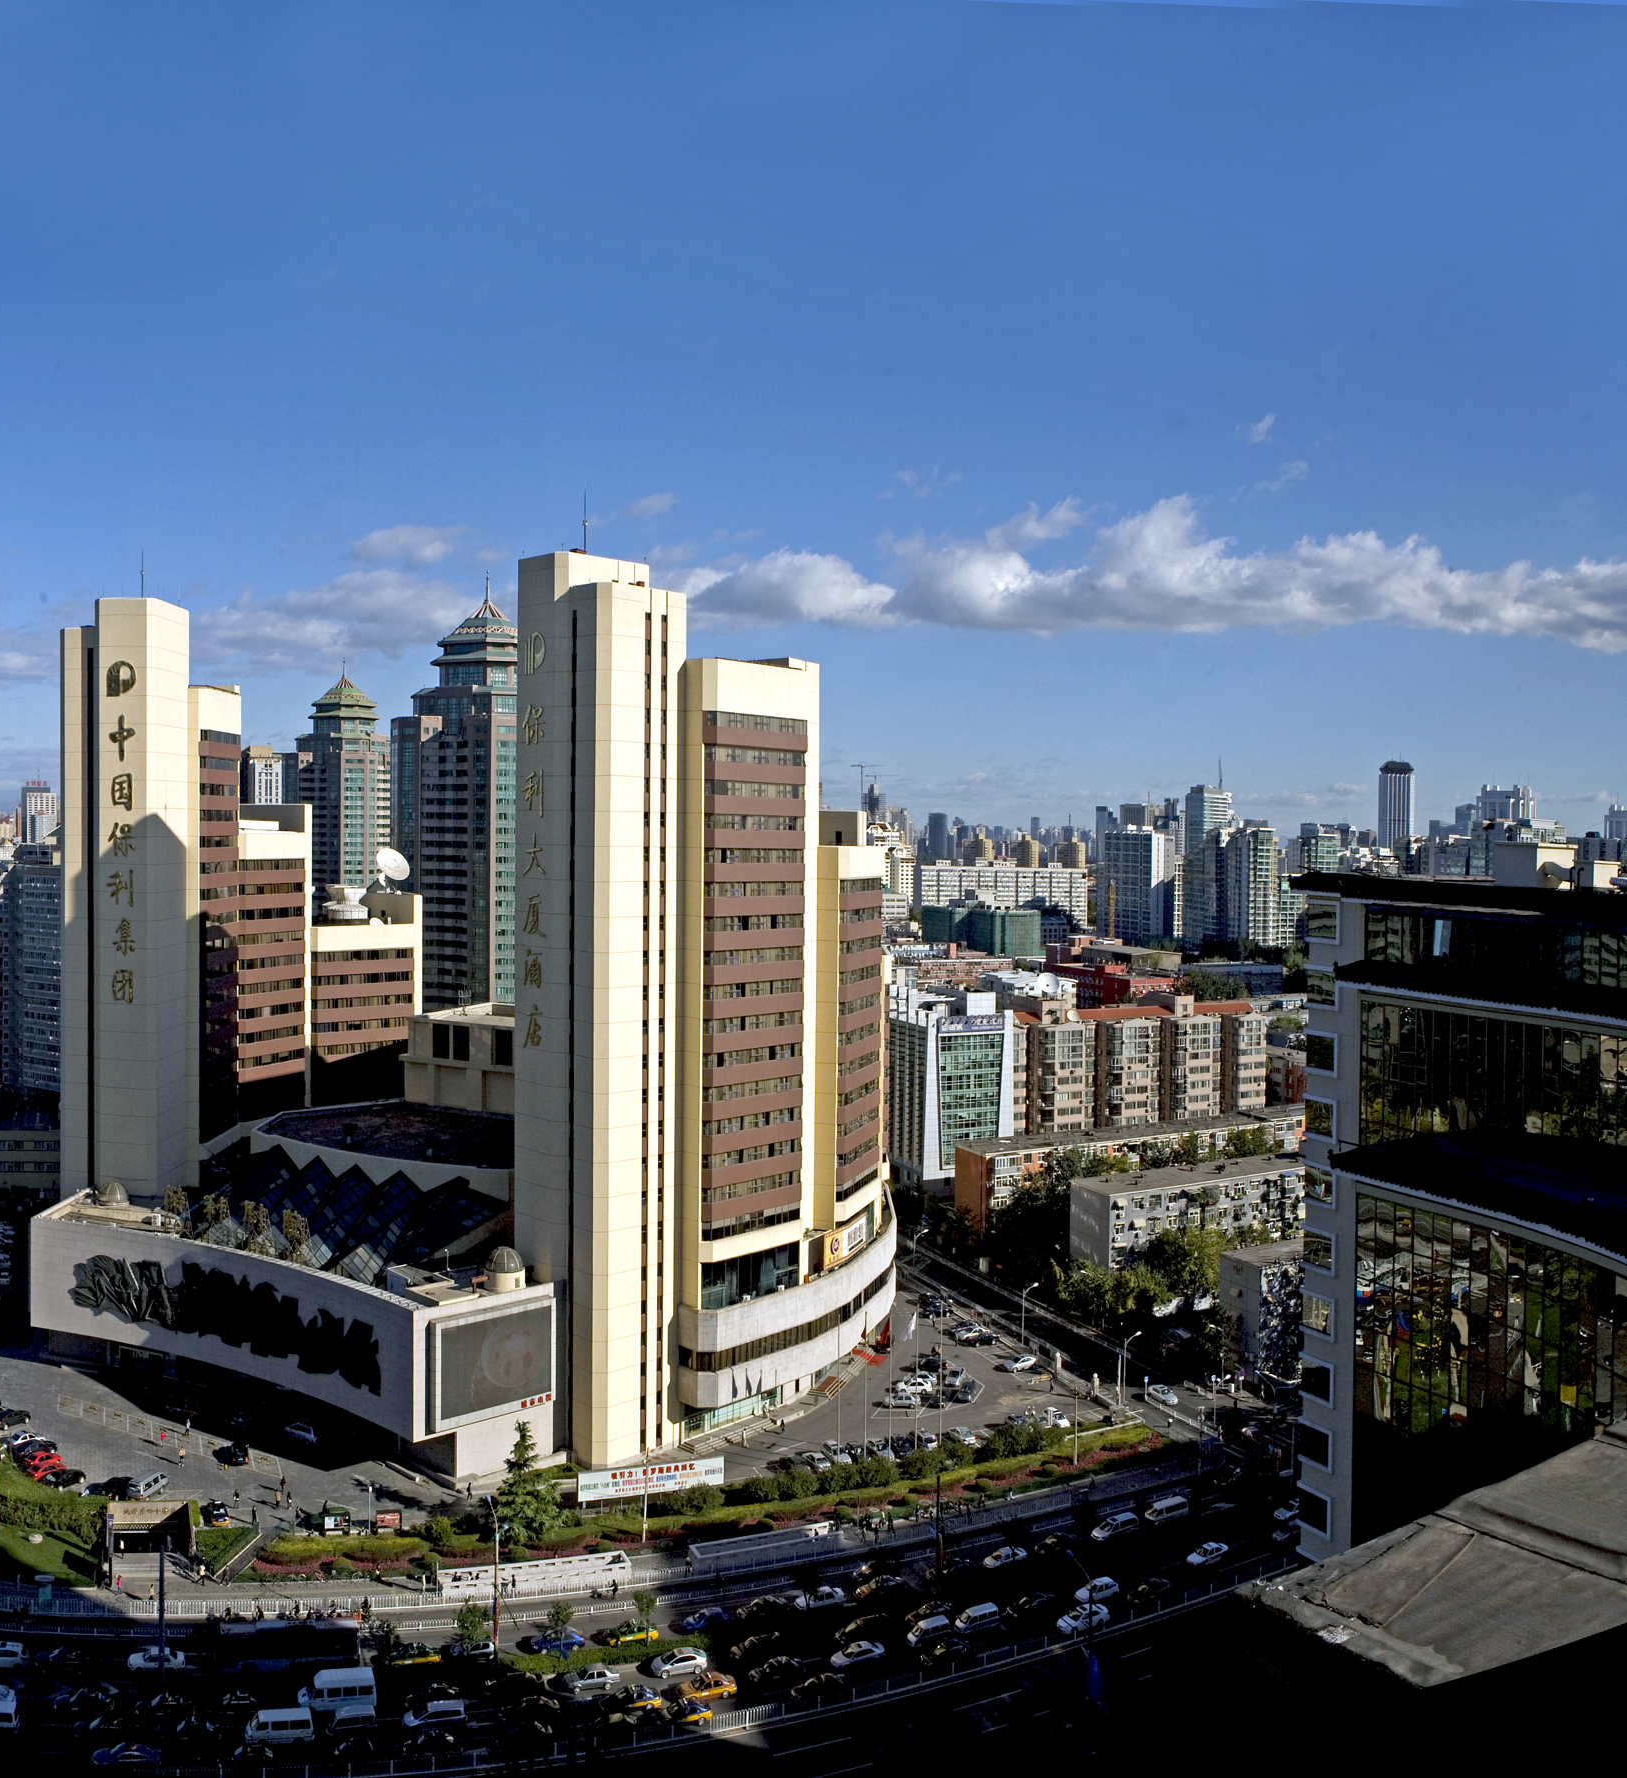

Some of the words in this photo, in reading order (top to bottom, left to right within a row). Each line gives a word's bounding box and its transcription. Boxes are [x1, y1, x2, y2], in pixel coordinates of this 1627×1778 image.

[106, 713, 136, 1004] 中国保利集团
[522, 703, 545, 1048] 保利大厦酒店
